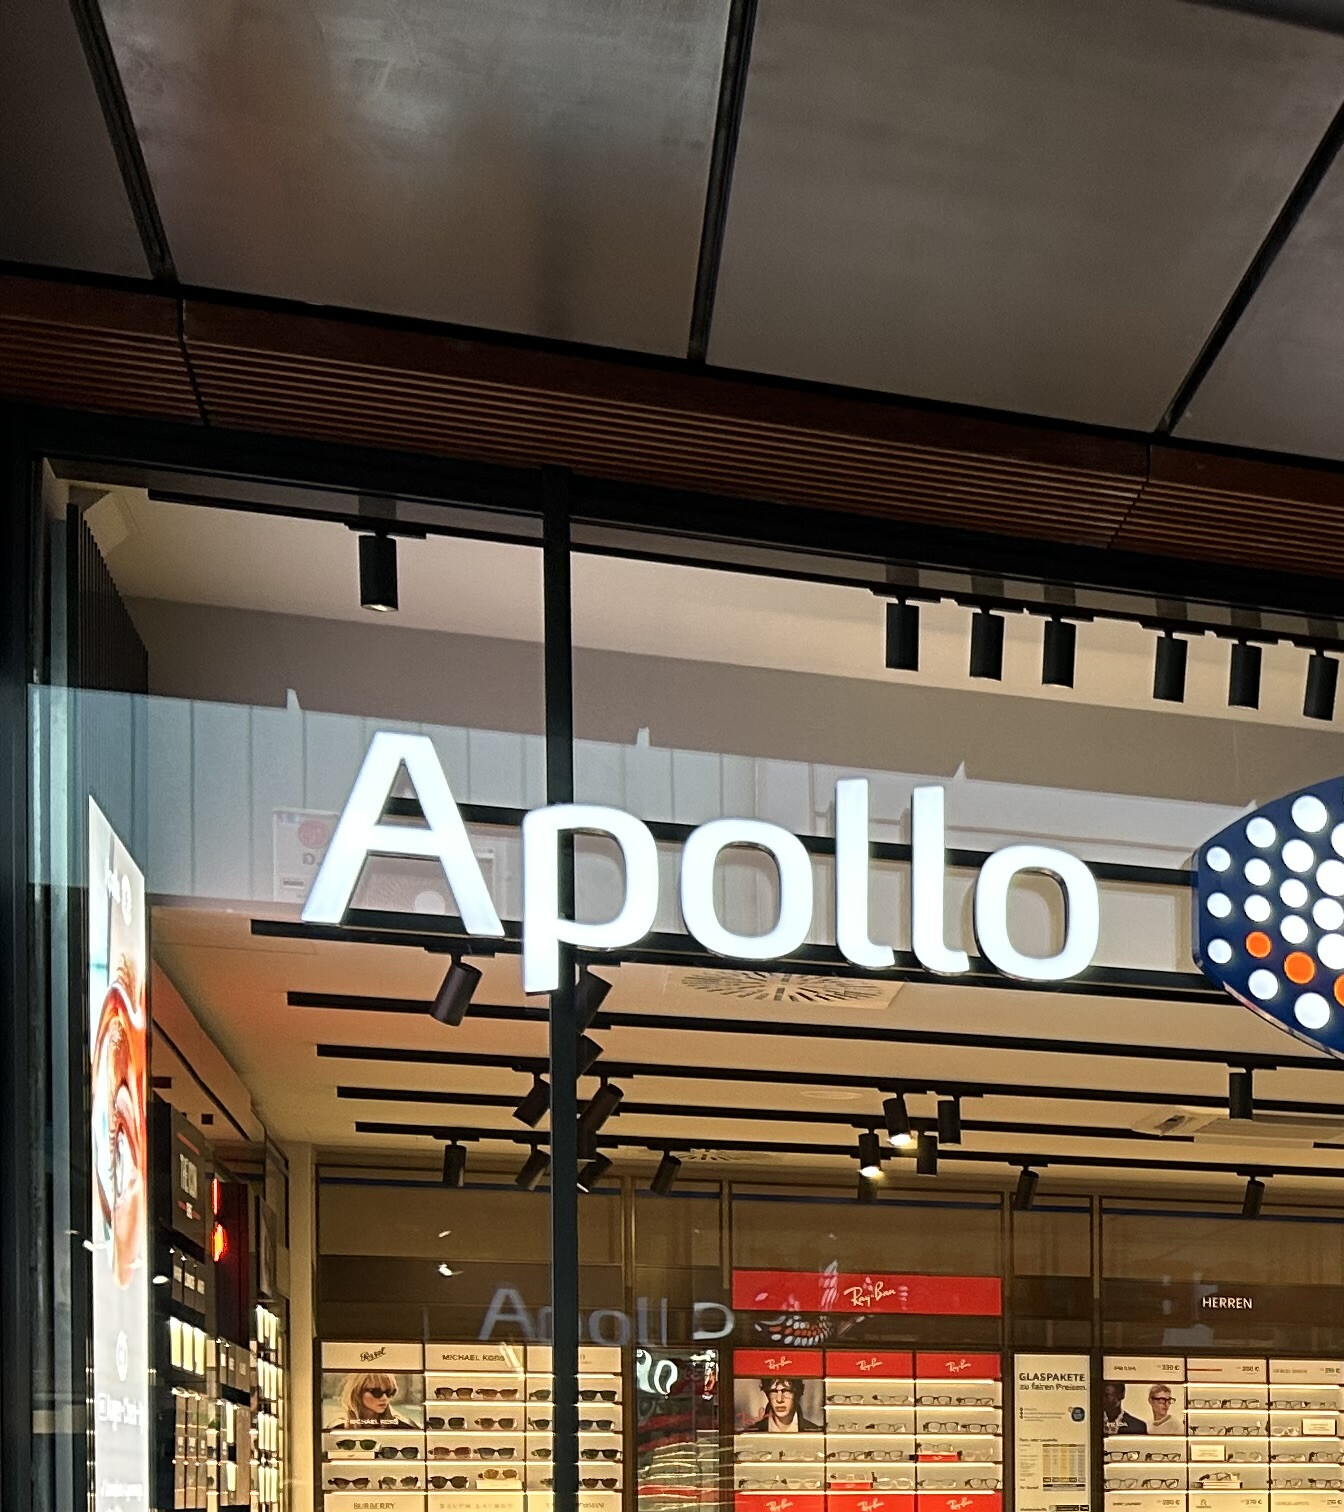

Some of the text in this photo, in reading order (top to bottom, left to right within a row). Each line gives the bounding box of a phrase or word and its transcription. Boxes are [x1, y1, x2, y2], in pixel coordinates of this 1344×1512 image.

[301, 730, 1101, 994] Apollo
[843, 1281, 896, 1307] Ray-Ban
[1202, 1296, 1253, 1309] HERREN
[1019, 1372, 1085, 1382] GLASPAKETE
[353, 1502, 396, 1511] BURBERRY
